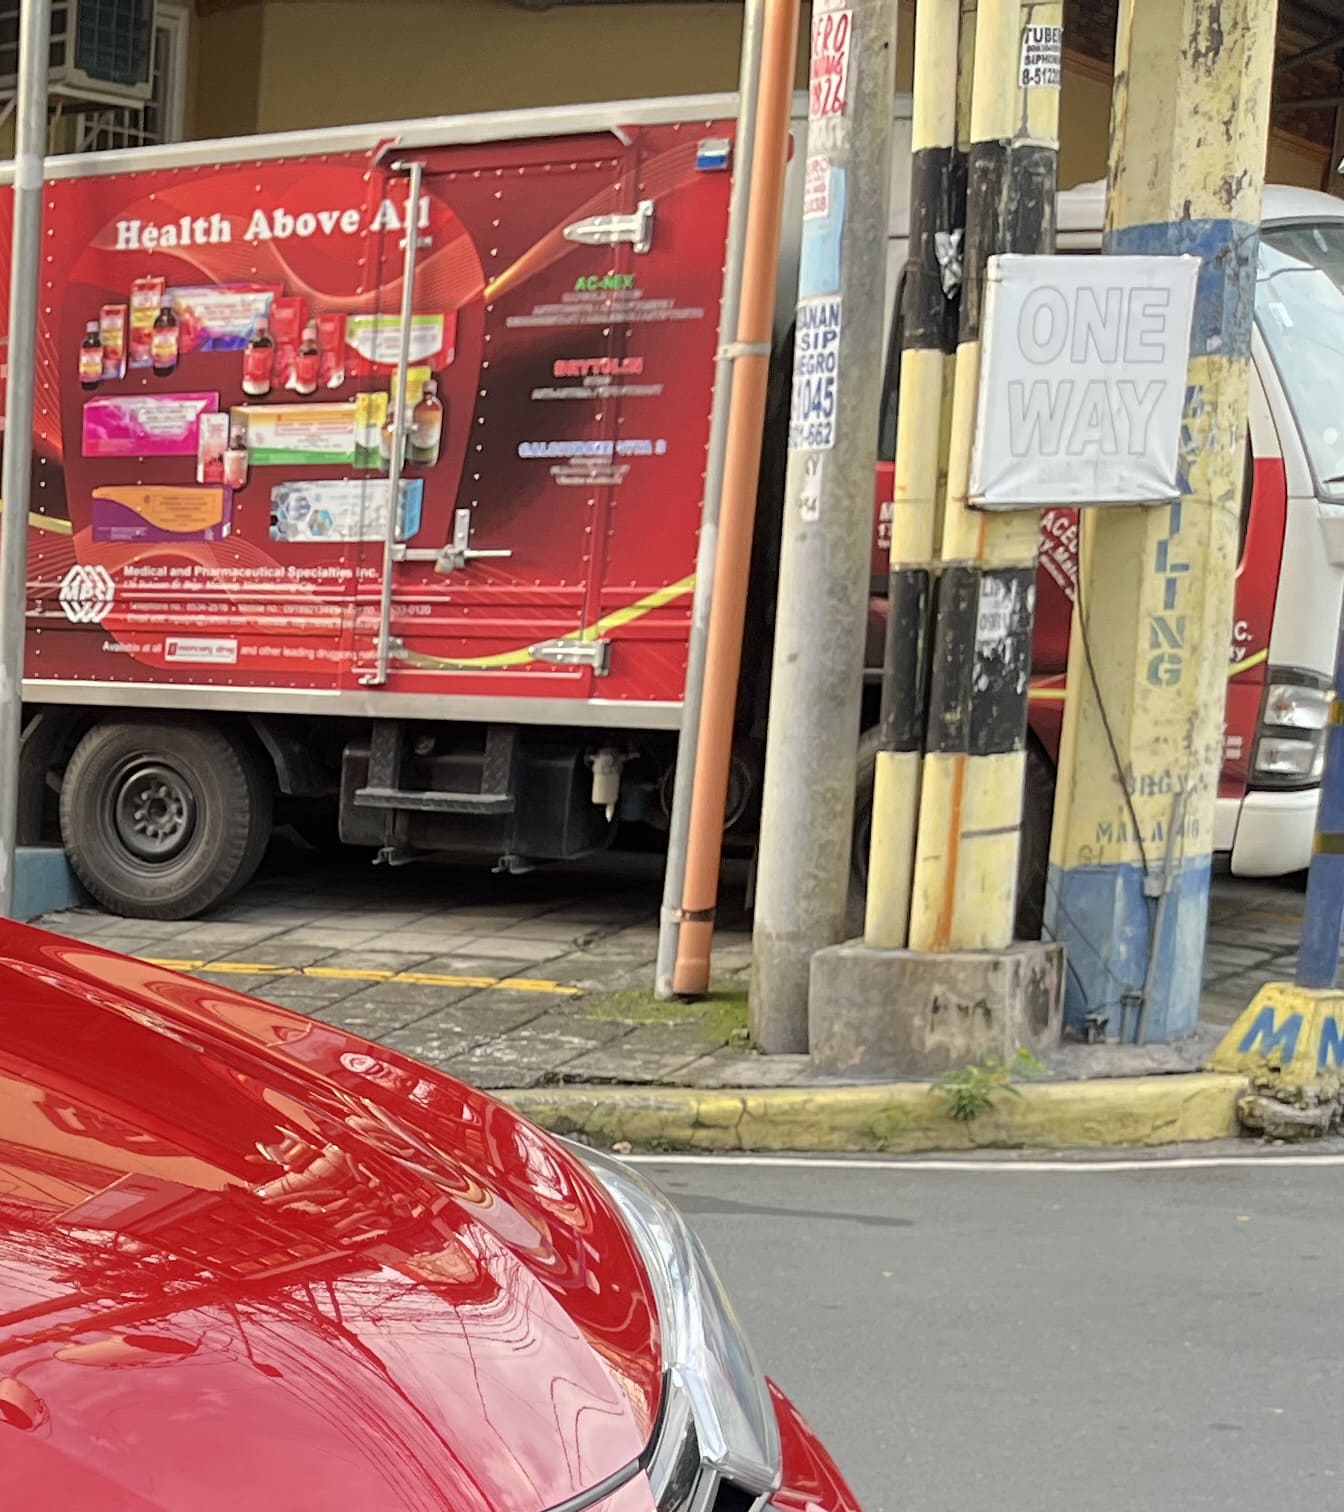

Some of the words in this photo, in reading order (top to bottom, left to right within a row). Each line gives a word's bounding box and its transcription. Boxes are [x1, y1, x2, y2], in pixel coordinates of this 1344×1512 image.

[115, 213, 232, 250] Health
[243, 208, 360, 241] Above
[801, 331, 837, 351] SIP
[1017, 285, 1170, 365] ONE
[1008, 379, 1167, 458] WAY
[123, 565, 167, 577] Medical
[170, 565, 192, 577] and
[194, 565, 285, 578] Pharmaceutical
[287, 566, 353, 580] Specialties
[356, 567, 379, 578] Inc.
